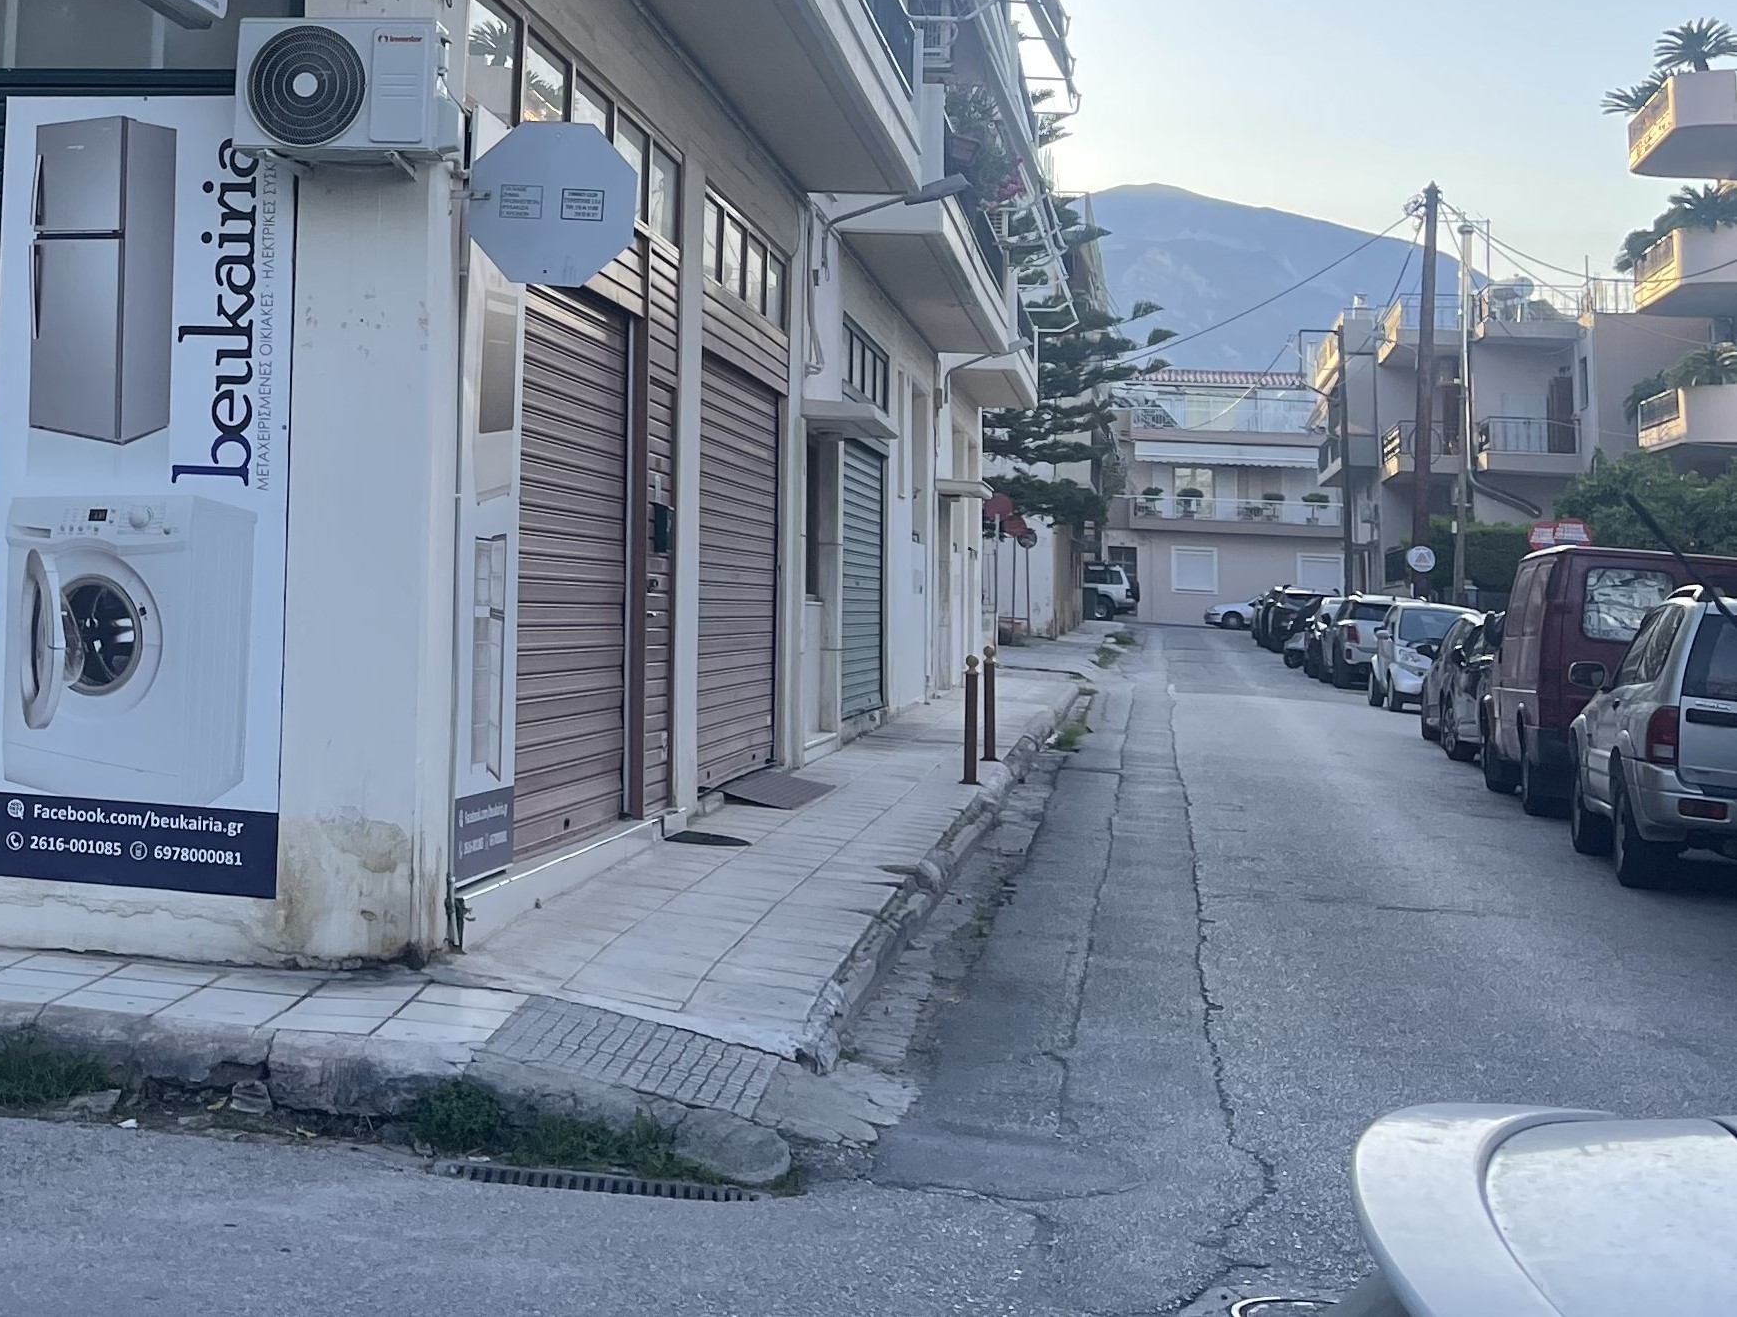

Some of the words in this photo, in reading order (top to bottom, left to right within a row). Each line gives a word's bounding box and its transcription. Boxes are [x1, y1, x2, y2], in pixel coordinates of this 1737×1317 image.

[262, 200, 277, 279] ΗΛΕΚΤΡΙΚΕΣ
[172, 138, 260, 487] beukairia
[259, 292, 274, 356] ΟΙΚΙΑΚΕΣ
[257, 360, 272, 491] ΜΕΤΑΧΕΙΡΙΣΜΕΝΕΣ
[29, 835, 122, 857] 2616-001085
[153, 845, 243, 866] 6978000081
[33, 803, 244, 837] Facebook.com/beukairia.gr
